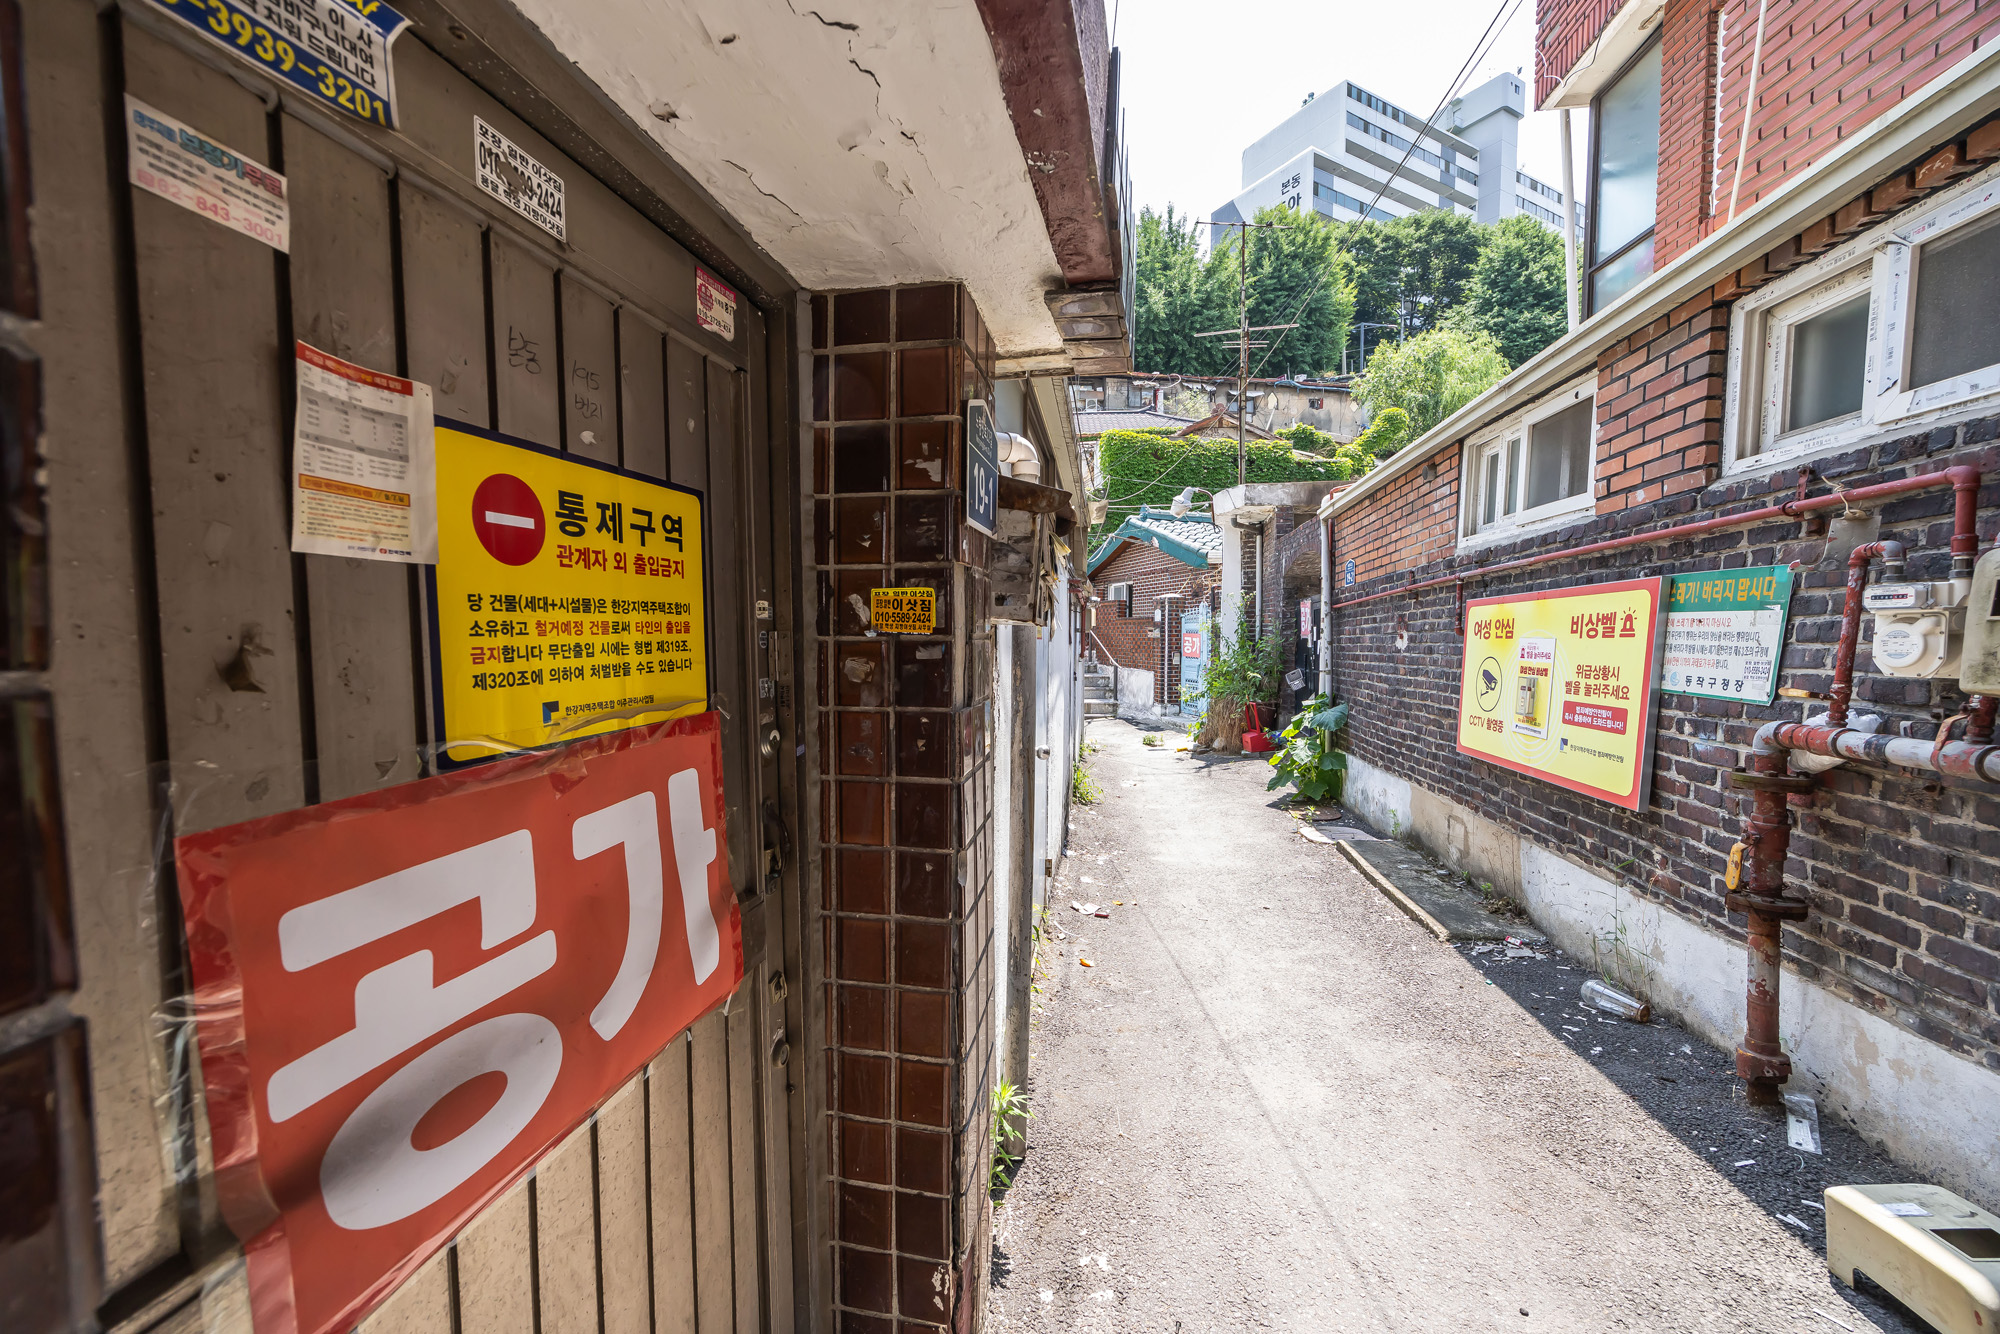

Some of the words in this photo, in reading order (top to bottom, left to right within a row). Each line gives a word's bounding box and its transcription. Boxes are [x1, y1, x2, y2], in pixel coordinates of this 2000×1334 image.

[263, 4, 303, 43] 치워
[307, 32, 377, 90] 드립니다
[268, 0, 374, 69] 바구니대여
[152, 0, 387, 127] -3939-3201
[507, 145, 529, 170] 일반
[532, 163, 563, 194] 이삿짐
[1281, 172, 1300, 195] 본동
[157, 178, 283, 245] 02-843-3001
[523, 203, 563, 233] 지방이삿짐
[508, 325, 542, 375] 본동
[572, 359, 600, 392] 195
[973, 462, 994, 521] 19-1
[555, 489, 683, 553] 통제구역
[556, 544, 608, 572] 관계자
[613, 552, 627, 574] 외
[633, 553, 685, 580] 출입금지
[1702, 579, 1735, 603] 버리지
[1737, 576, 1776, 602] 맙시다
[467, 593, 484, 613] 당
[489, 594, 608, 615] 건물(세대+시설물)은
[611, 599, 691, 616] 한강지역주택조합이
[892, 598, 931, 612] 이삿짐
[469, 620, 530, 639] 소유하고
[535, 619, 584, 637] 철거예정
[588, 620, 631, 636] 건물로써
[635, 620, 663, 635] 타인의
[665, 620, 691, 635] 출입을
[1474, 619, 1492, 640] 여성
[1494, 618, 1515, 640] 안심
[1570, 611, 1617, 639] 비상벨
[470, 644, 543, 665] 금지합니다
[548, 642, 595, 660] 무단출입
[599, 641, 630, 657] 시에는
[634, 640, 652, 656] 형법
[656, 640, 692, 654] 제319조,
[1183, 636, 1200, 654] 공가
[472, 668, 544, 691] 제320조에
[549, 664, 584, 684] 의하여
[590, 661, 632, 680] 처벌받을
[636, 660, 655, 676] 수도
[658, 657, 693, 674] 있습니다
[1576, 664, 1620, 682] 위급상황시
[1685, 674, 1744, 692] 동작구청장
[1565, 680, 1581, 696] 벨을
[1583, 682, 1630, 700] 눌러주세요
[565, 701, 615, 716] 한강지역주택조합
[616, 695, 655, 707] 이주관리사업팀
[1575, 706, 1612, 719] 범죄예방안전팀이
[1469, 715, 1485, 728] CCTV
[1486, 718, 1504, 733] 촬영중
[1564, 712, 1574, 722] 즉시
[1574, 714, 1592, 725] 출동하여
[1592, 718, 1624, 731] 도와드립니다!
[266, 767, 717, 1231] 공가
